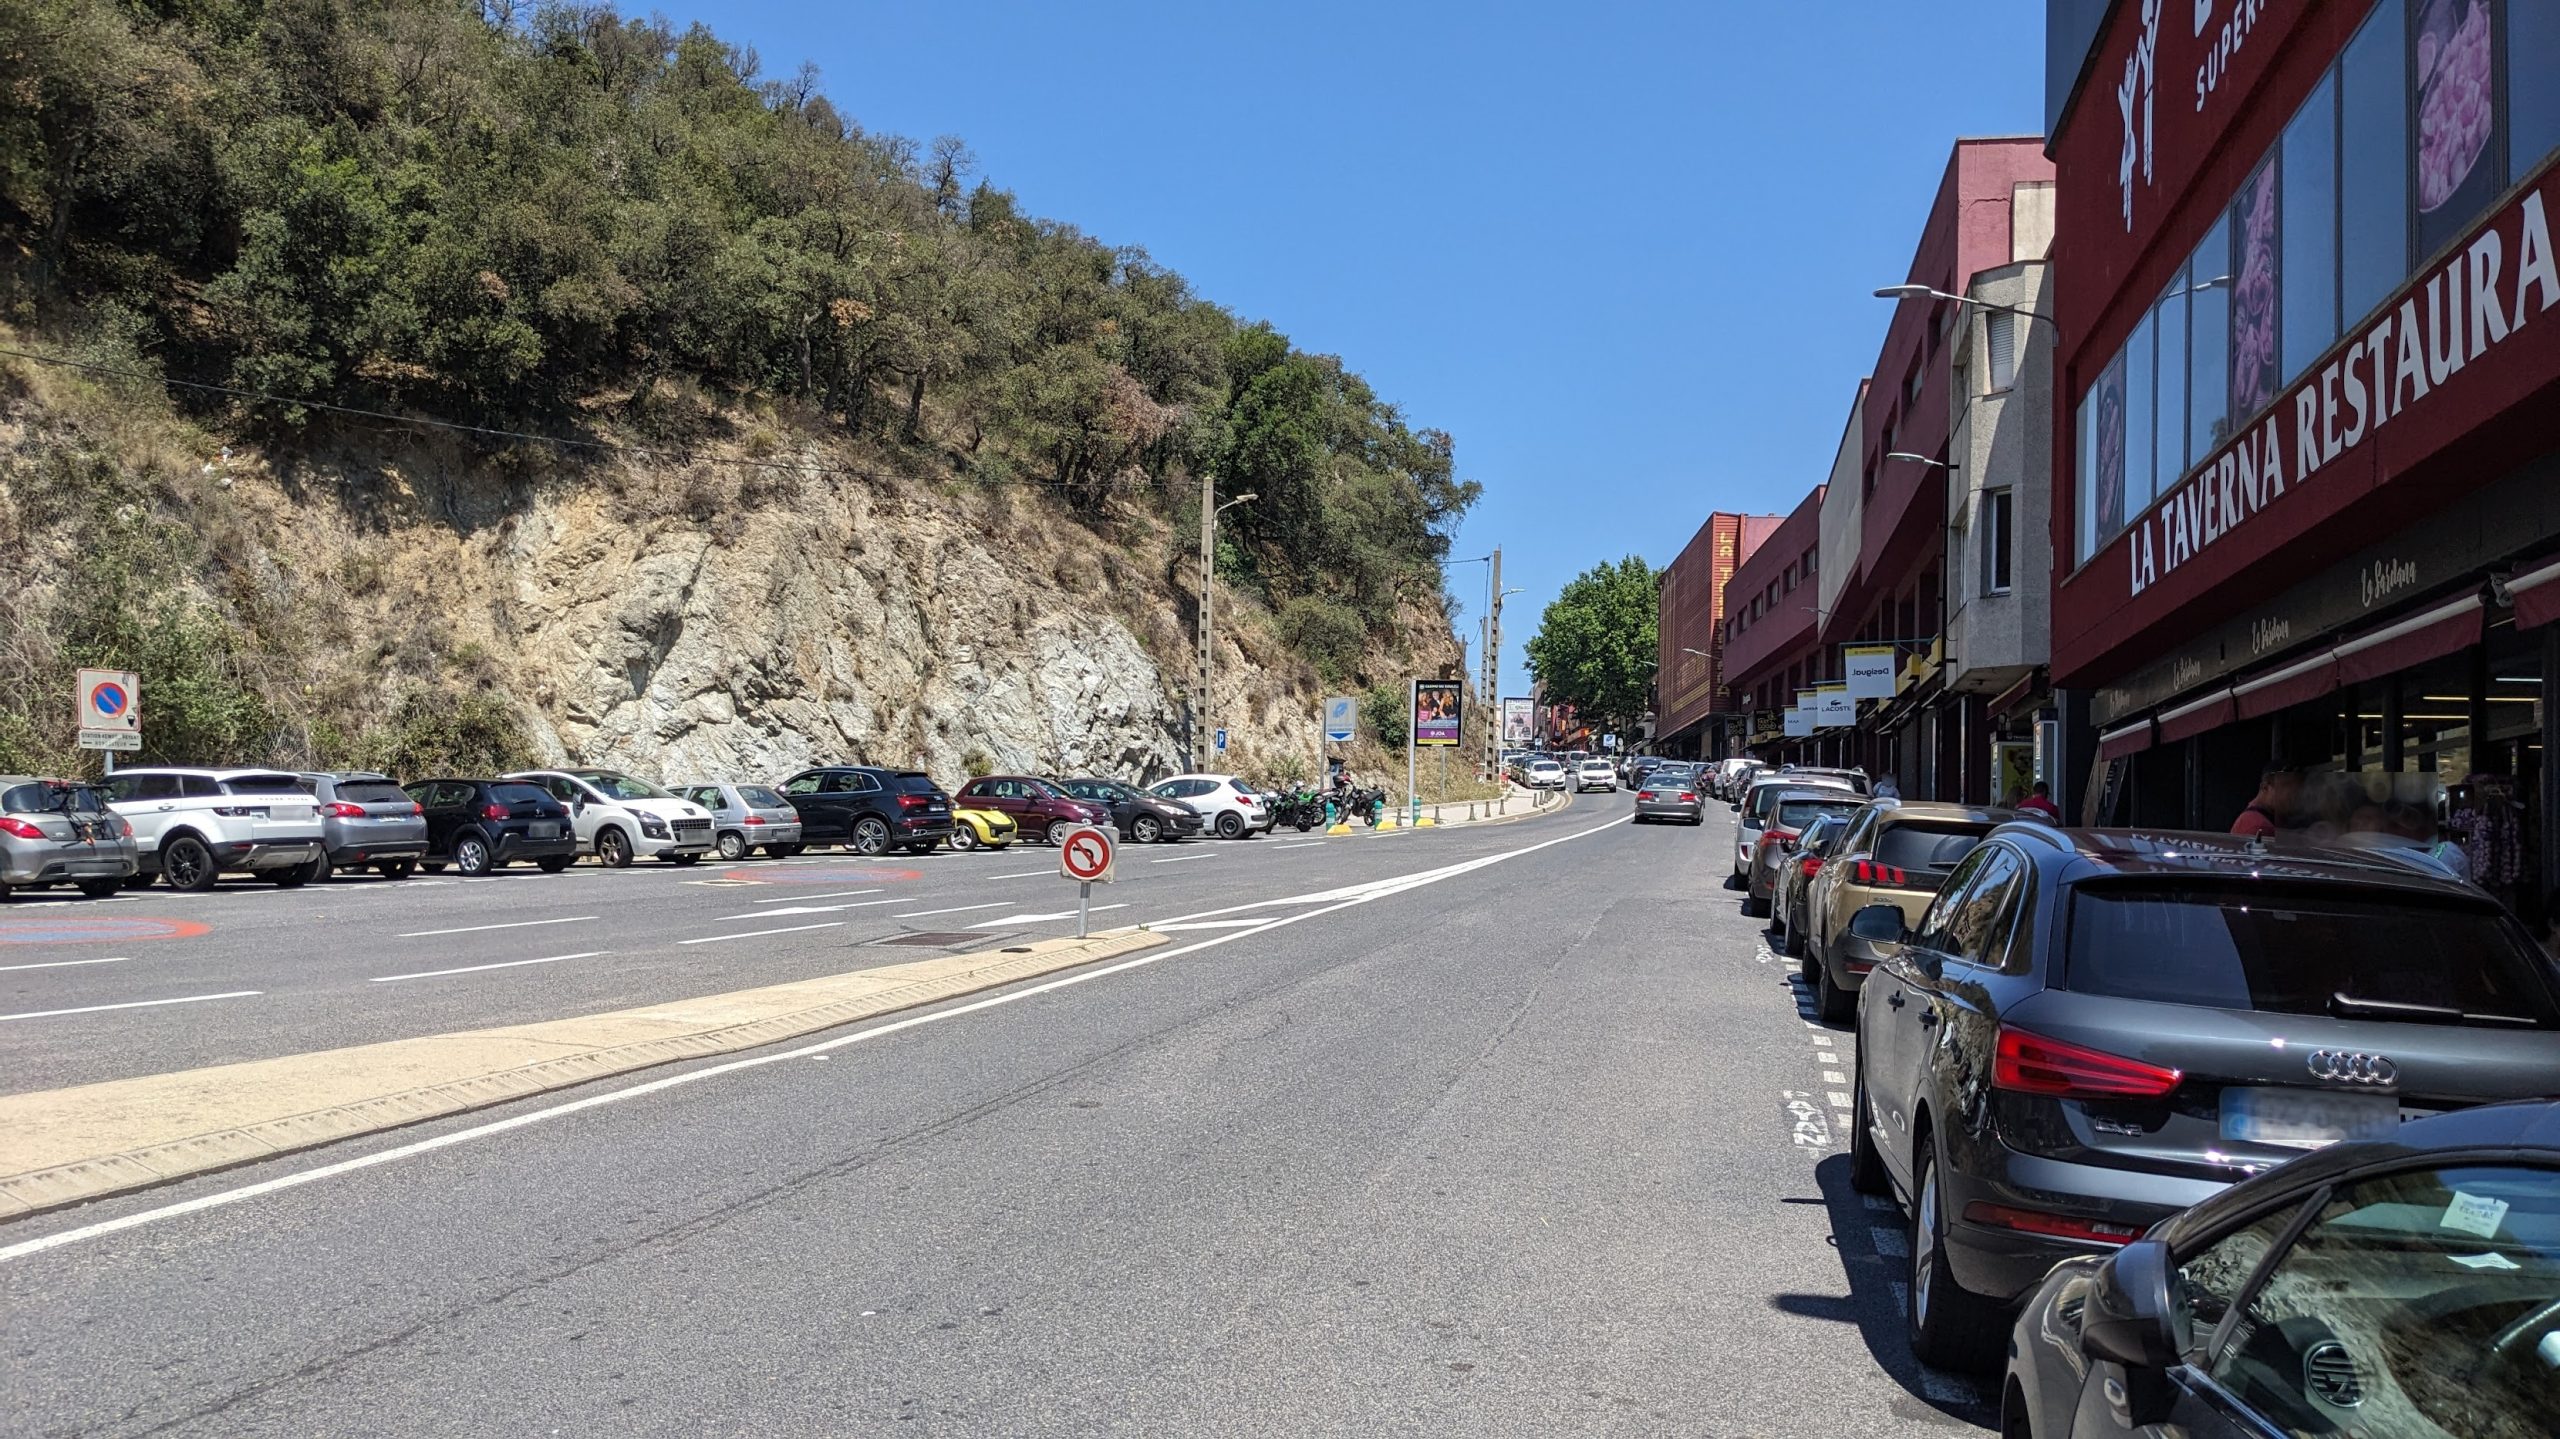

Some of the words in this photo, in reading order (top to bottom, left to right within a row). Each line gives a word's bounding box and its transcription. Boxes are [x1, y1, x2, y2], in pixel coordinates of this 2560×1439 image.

[2196, 0, 2265, 113] SUPER
[2129, 521, 2156, 597] LA
[2161, 414, 2285, 574] TAVERNA
[2295, 188, 2560, 484] RESTAURA
[1821, 704, 1852, 713] LACOSTE
